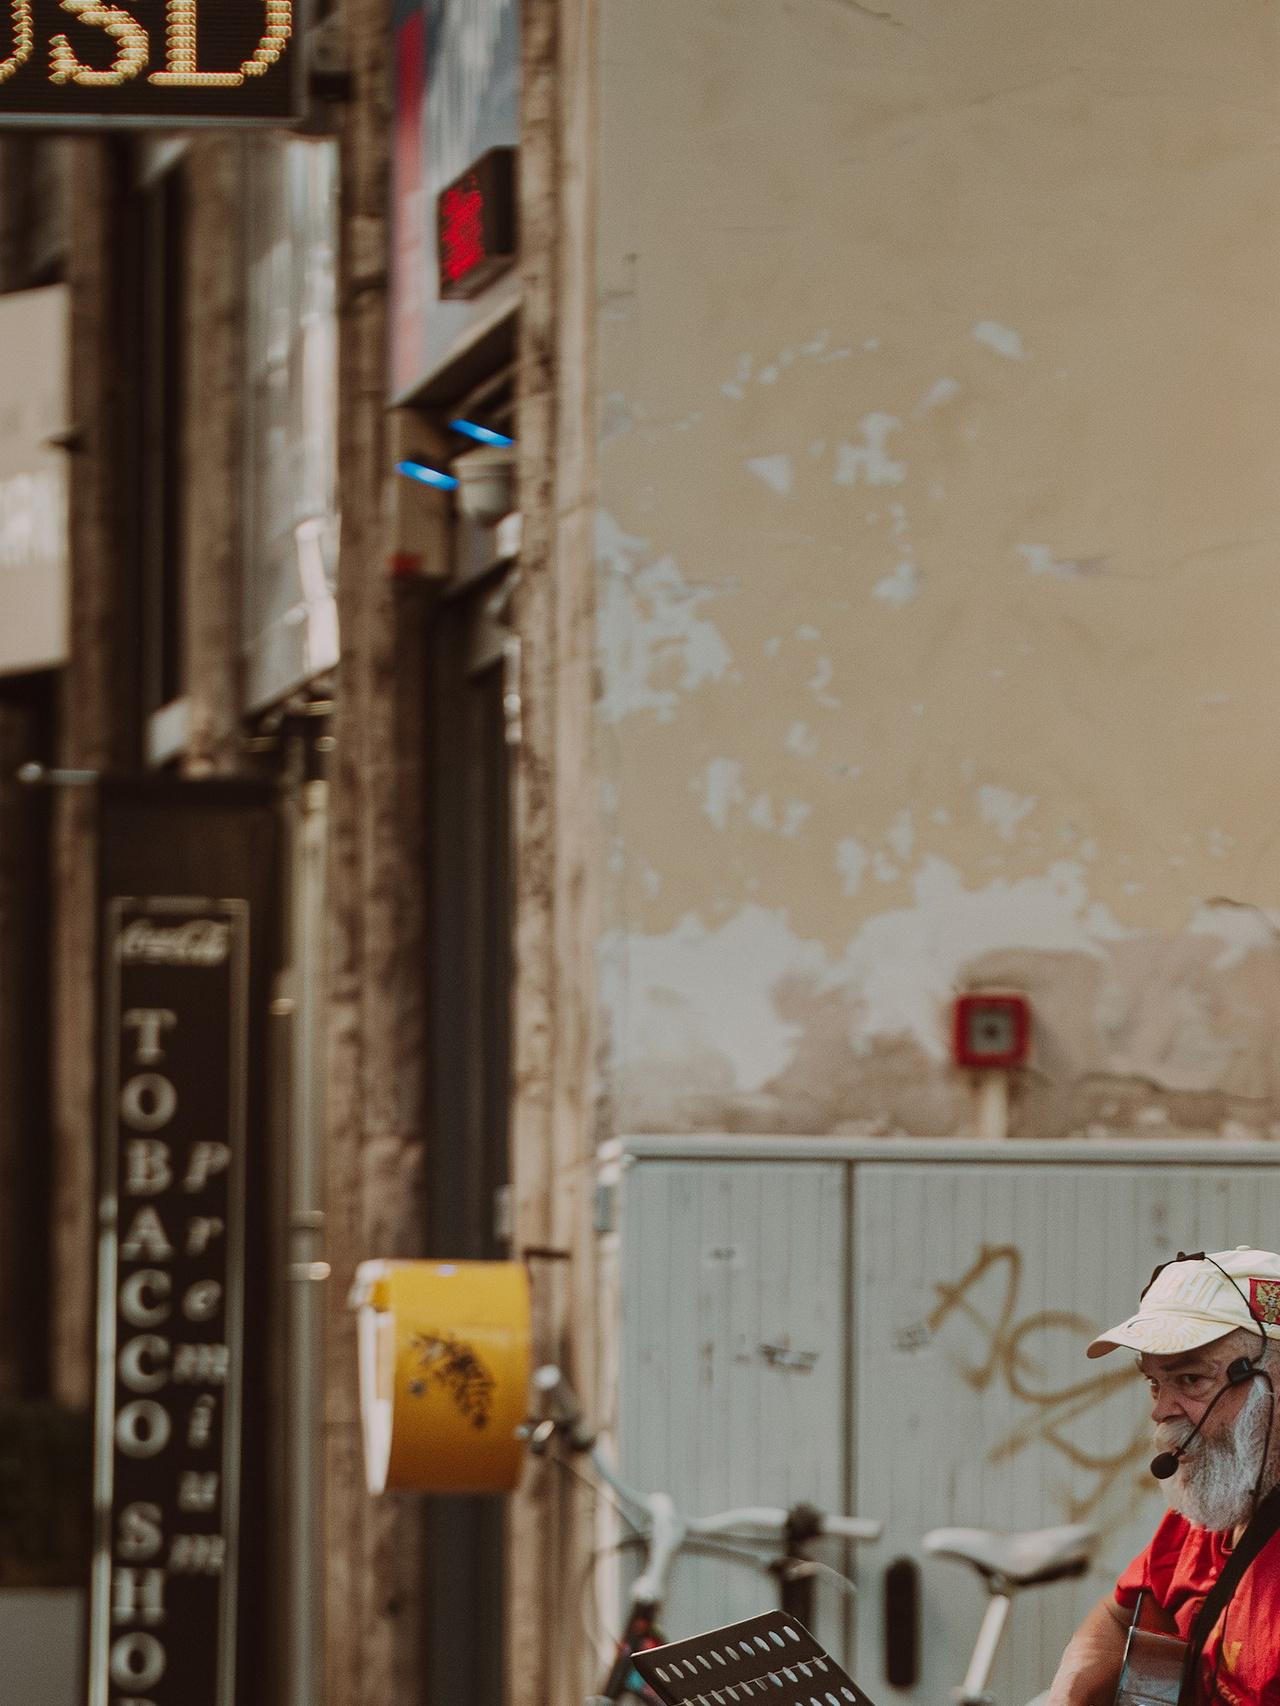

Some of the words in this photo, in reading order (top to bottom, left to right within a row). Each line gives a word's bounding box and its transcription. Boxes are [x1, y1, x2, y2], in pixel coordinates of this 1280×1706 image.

[0, 0, 292, 86] SD
[113, 1007, 179, 1459] TOBACCO
[169, 1140, 232, 1577] Premium
